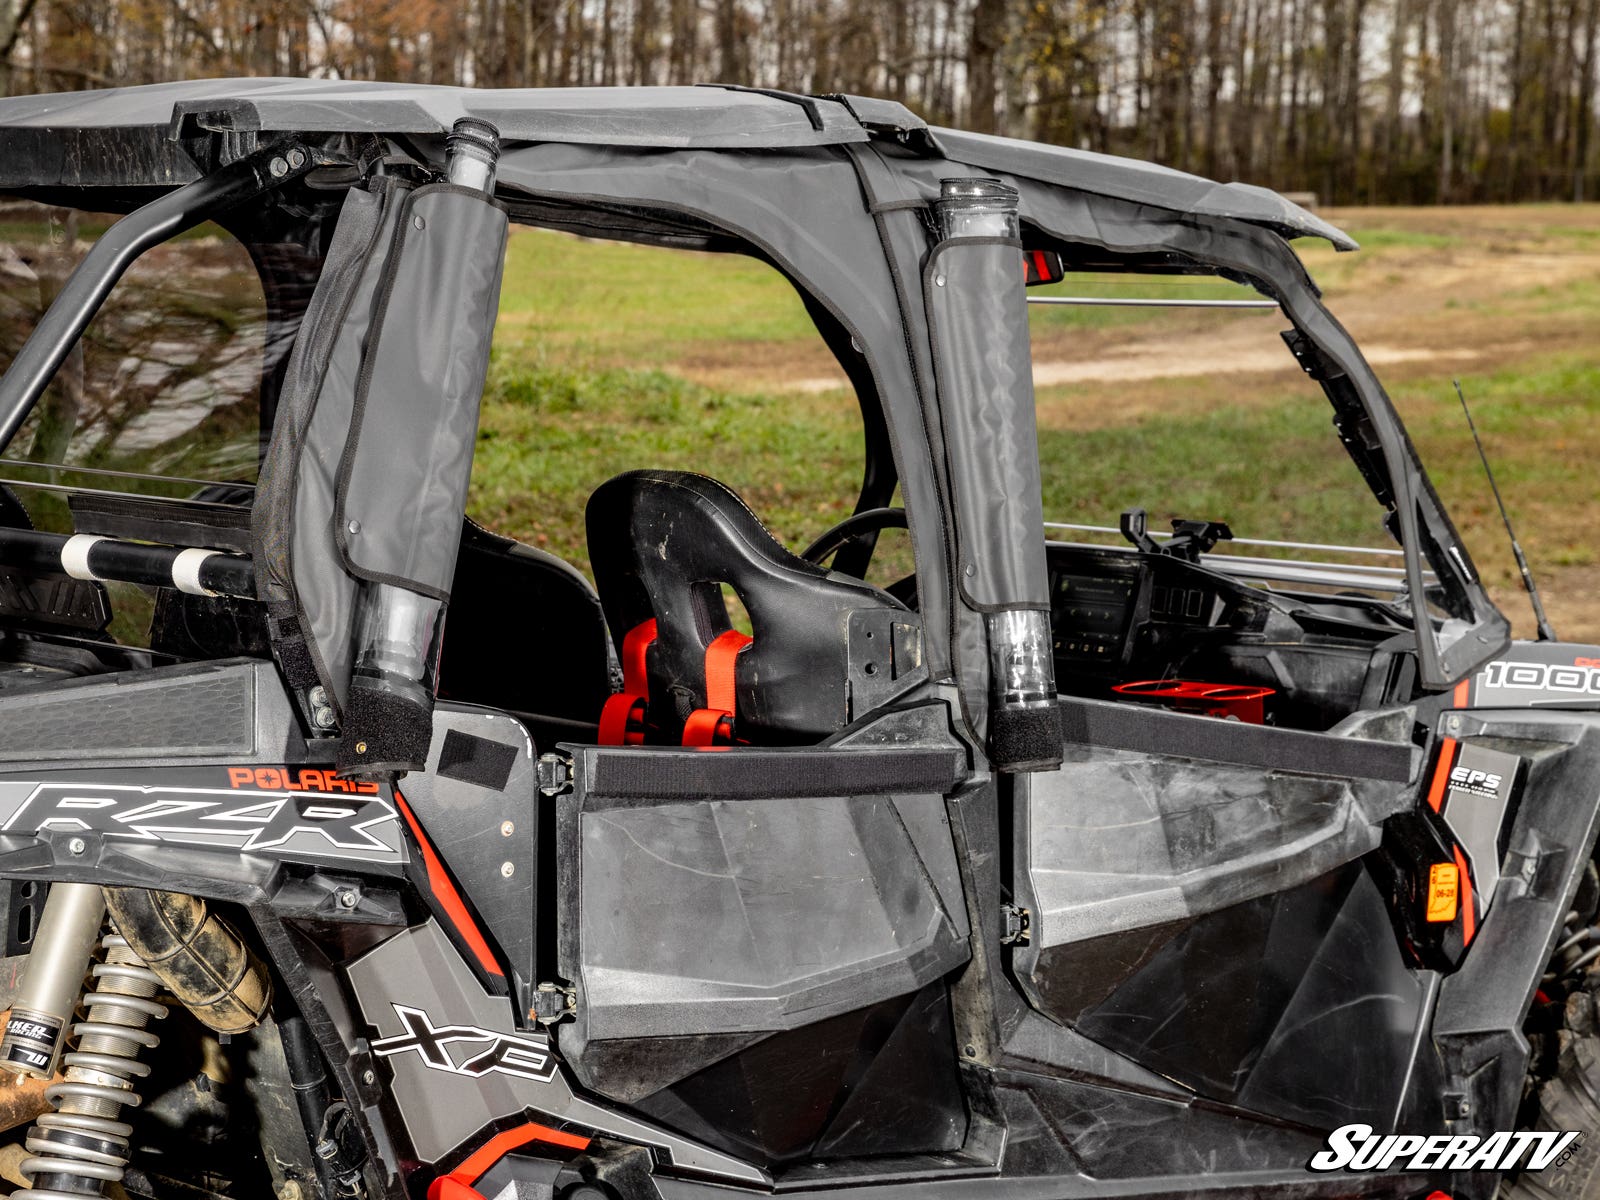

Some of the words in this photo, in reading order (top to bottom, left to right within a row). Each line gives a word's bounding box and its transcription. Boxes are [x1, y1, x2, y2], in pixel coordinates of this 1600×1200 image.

[1485, 661, 1600, 694] 100
[1450, 766, 1502, 789] EPS
[1, 782, 399, 852] RZR
